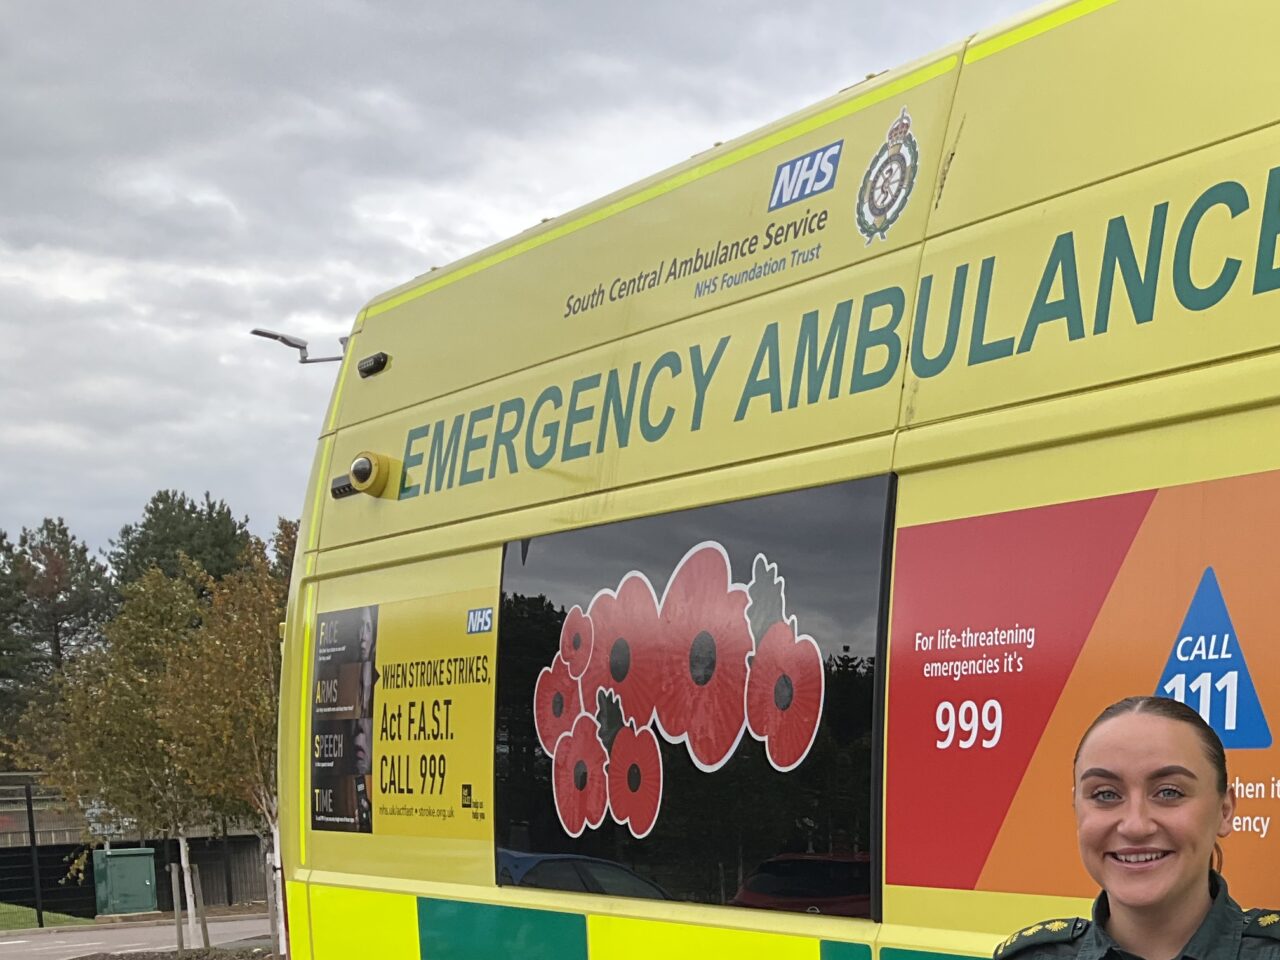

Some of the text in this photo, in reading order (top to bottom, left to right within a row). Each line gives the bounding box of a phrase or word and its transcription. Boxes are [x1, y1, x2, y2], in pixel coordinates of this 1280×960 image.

[769, 145, 839, 208] NHS
[564, 209, 828, 318] South Central Ambulance Service
[694, 243, 822, 300] NHS Foundation Trust
[399, 336, 730, 500] EMERGENCY
[468, 609, 492, 633] NHS
[915, 623, 1035, 651] For life-threatening
[1176, 634, 1232, 661] CALL
[382, 655, 491, 689] WHEN STROKE STRIKES,
[923, 651, 1023, 681] emergencies it's
[316, 679, 338, 704] ARMS
[380, 699, 454, 742] Act F.A.S.T.
[935, 699, 1003, 749] 999
[314, 734, 344, 758] SPEECH
[380, 753, 447, 795] CALL 999
[1232, 776, 1265, 799] hen
[314, 788, 333, 813] TIME
